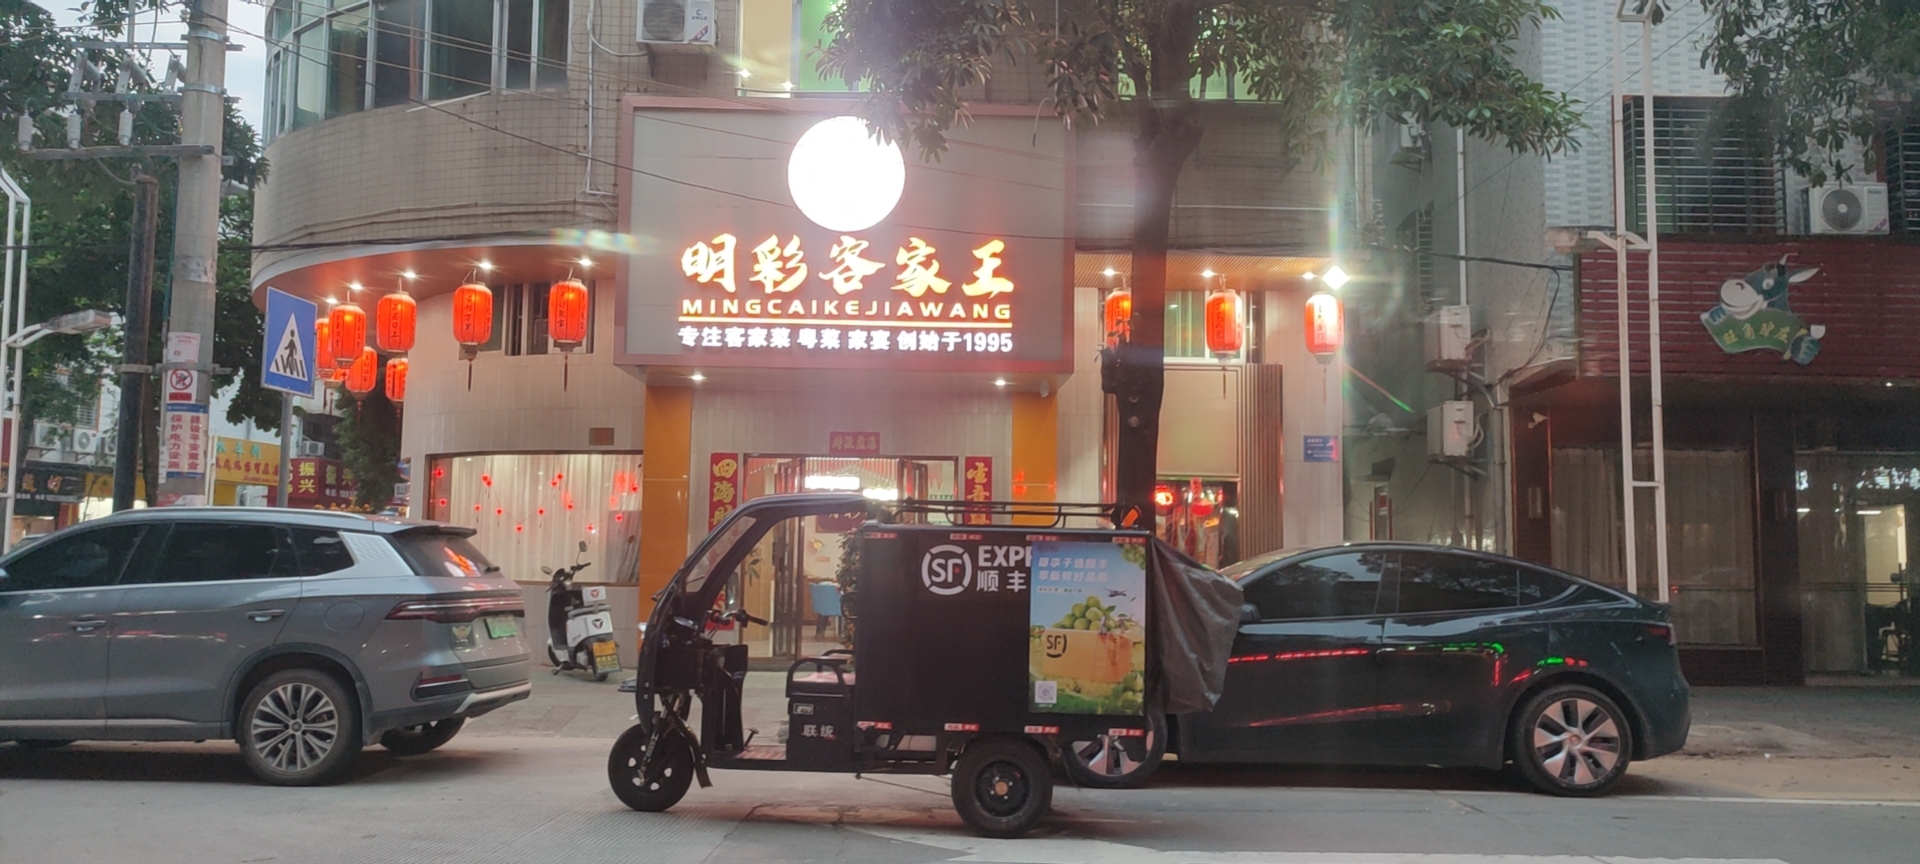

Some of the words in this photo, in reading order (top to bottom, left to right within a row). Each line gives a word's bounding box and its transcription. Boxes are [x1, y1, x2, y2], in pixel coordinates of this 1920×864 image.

[680, 233, 1015, 299] 明彩客家王
[682, 299, 1011, 319] MINGCAIKEJIAWANG
[678, 326, 791, 349] 专注客家菜
[797, 328, 841, 350] 粤菜
[848, 330, 890, 351] 家宴
[897, 331, 1013, 353] 创始于1995
[298, 461, 315, 494] 振兴
[976, 570, 1027, 592] 顺丰
